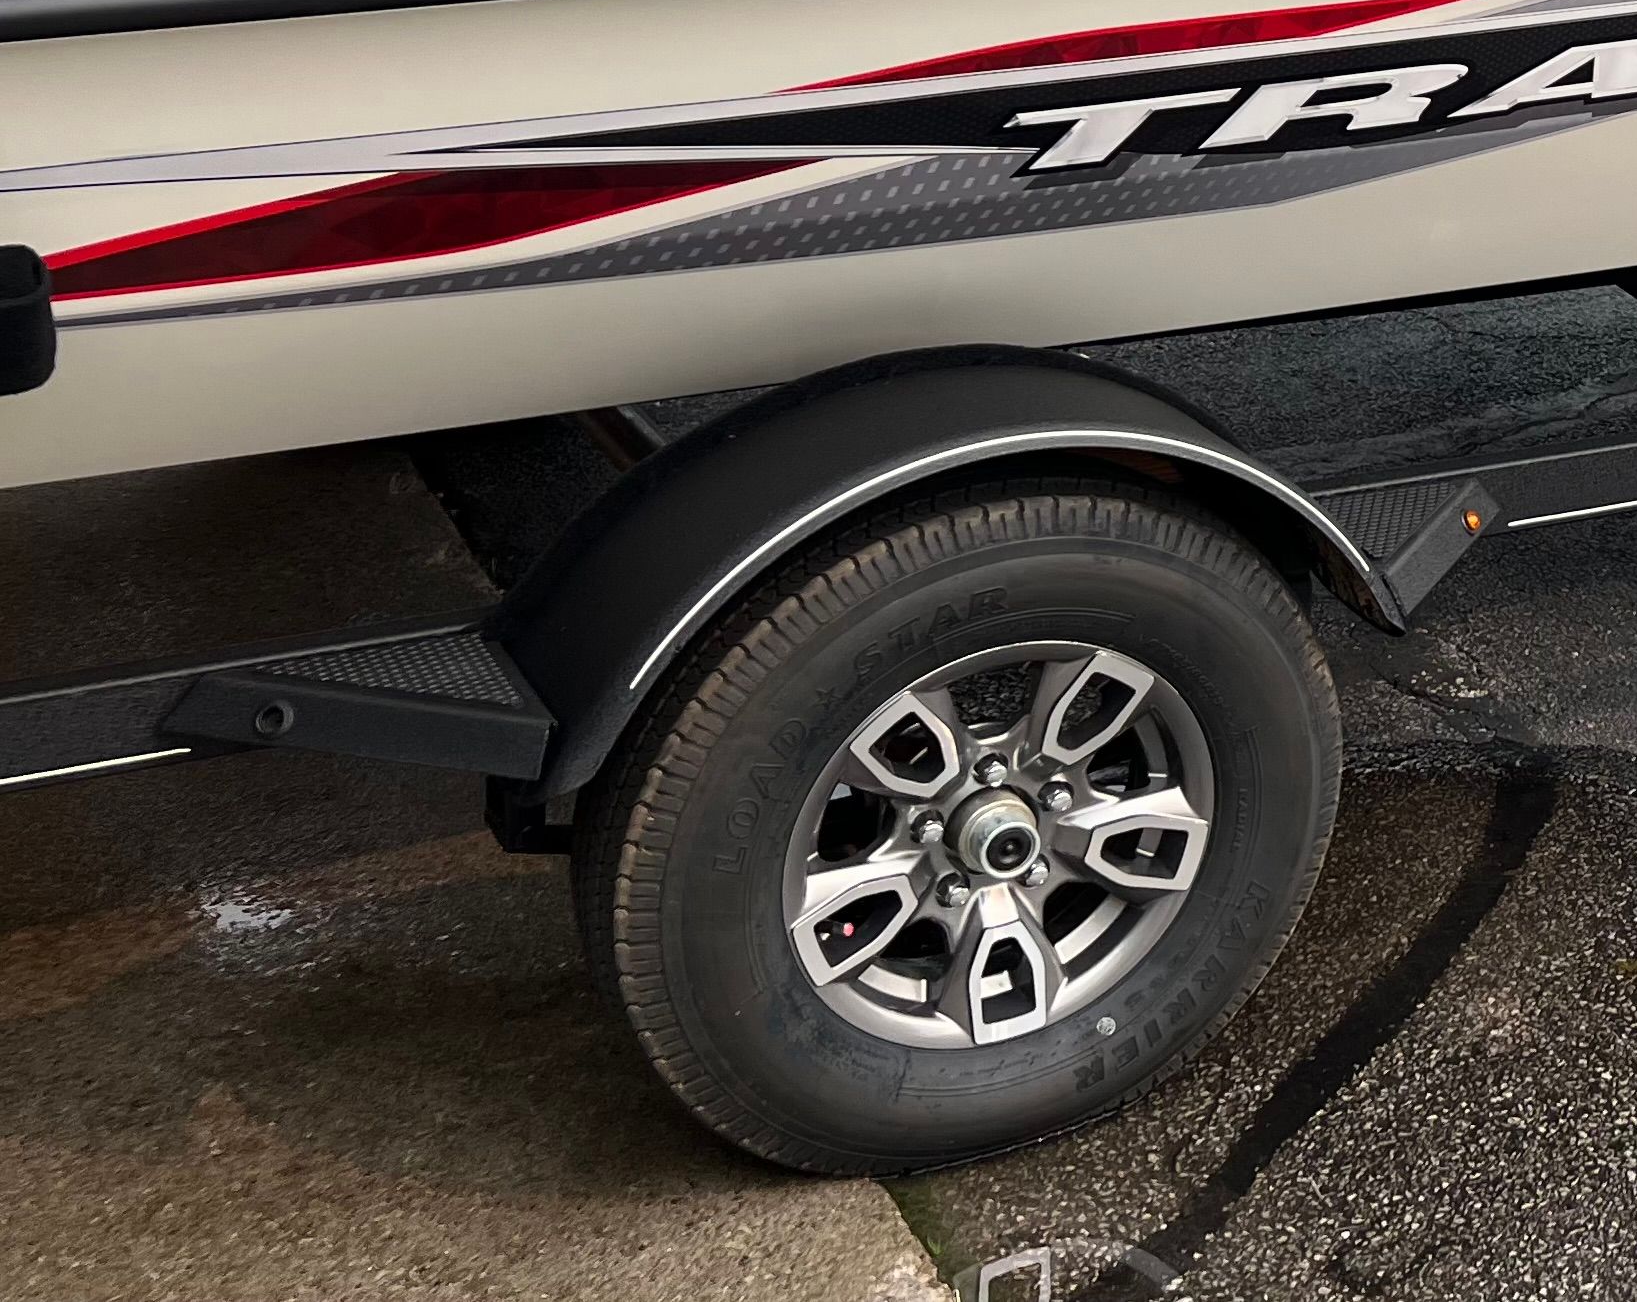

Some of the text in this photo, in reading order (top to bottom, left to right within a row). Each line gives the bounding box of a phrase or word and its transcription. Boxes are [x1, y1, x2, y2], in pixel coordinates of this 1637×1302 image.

[713, 585, 1010, 875] LOAD STAR
[1072, 880, 1271, 1093] KARRIER
